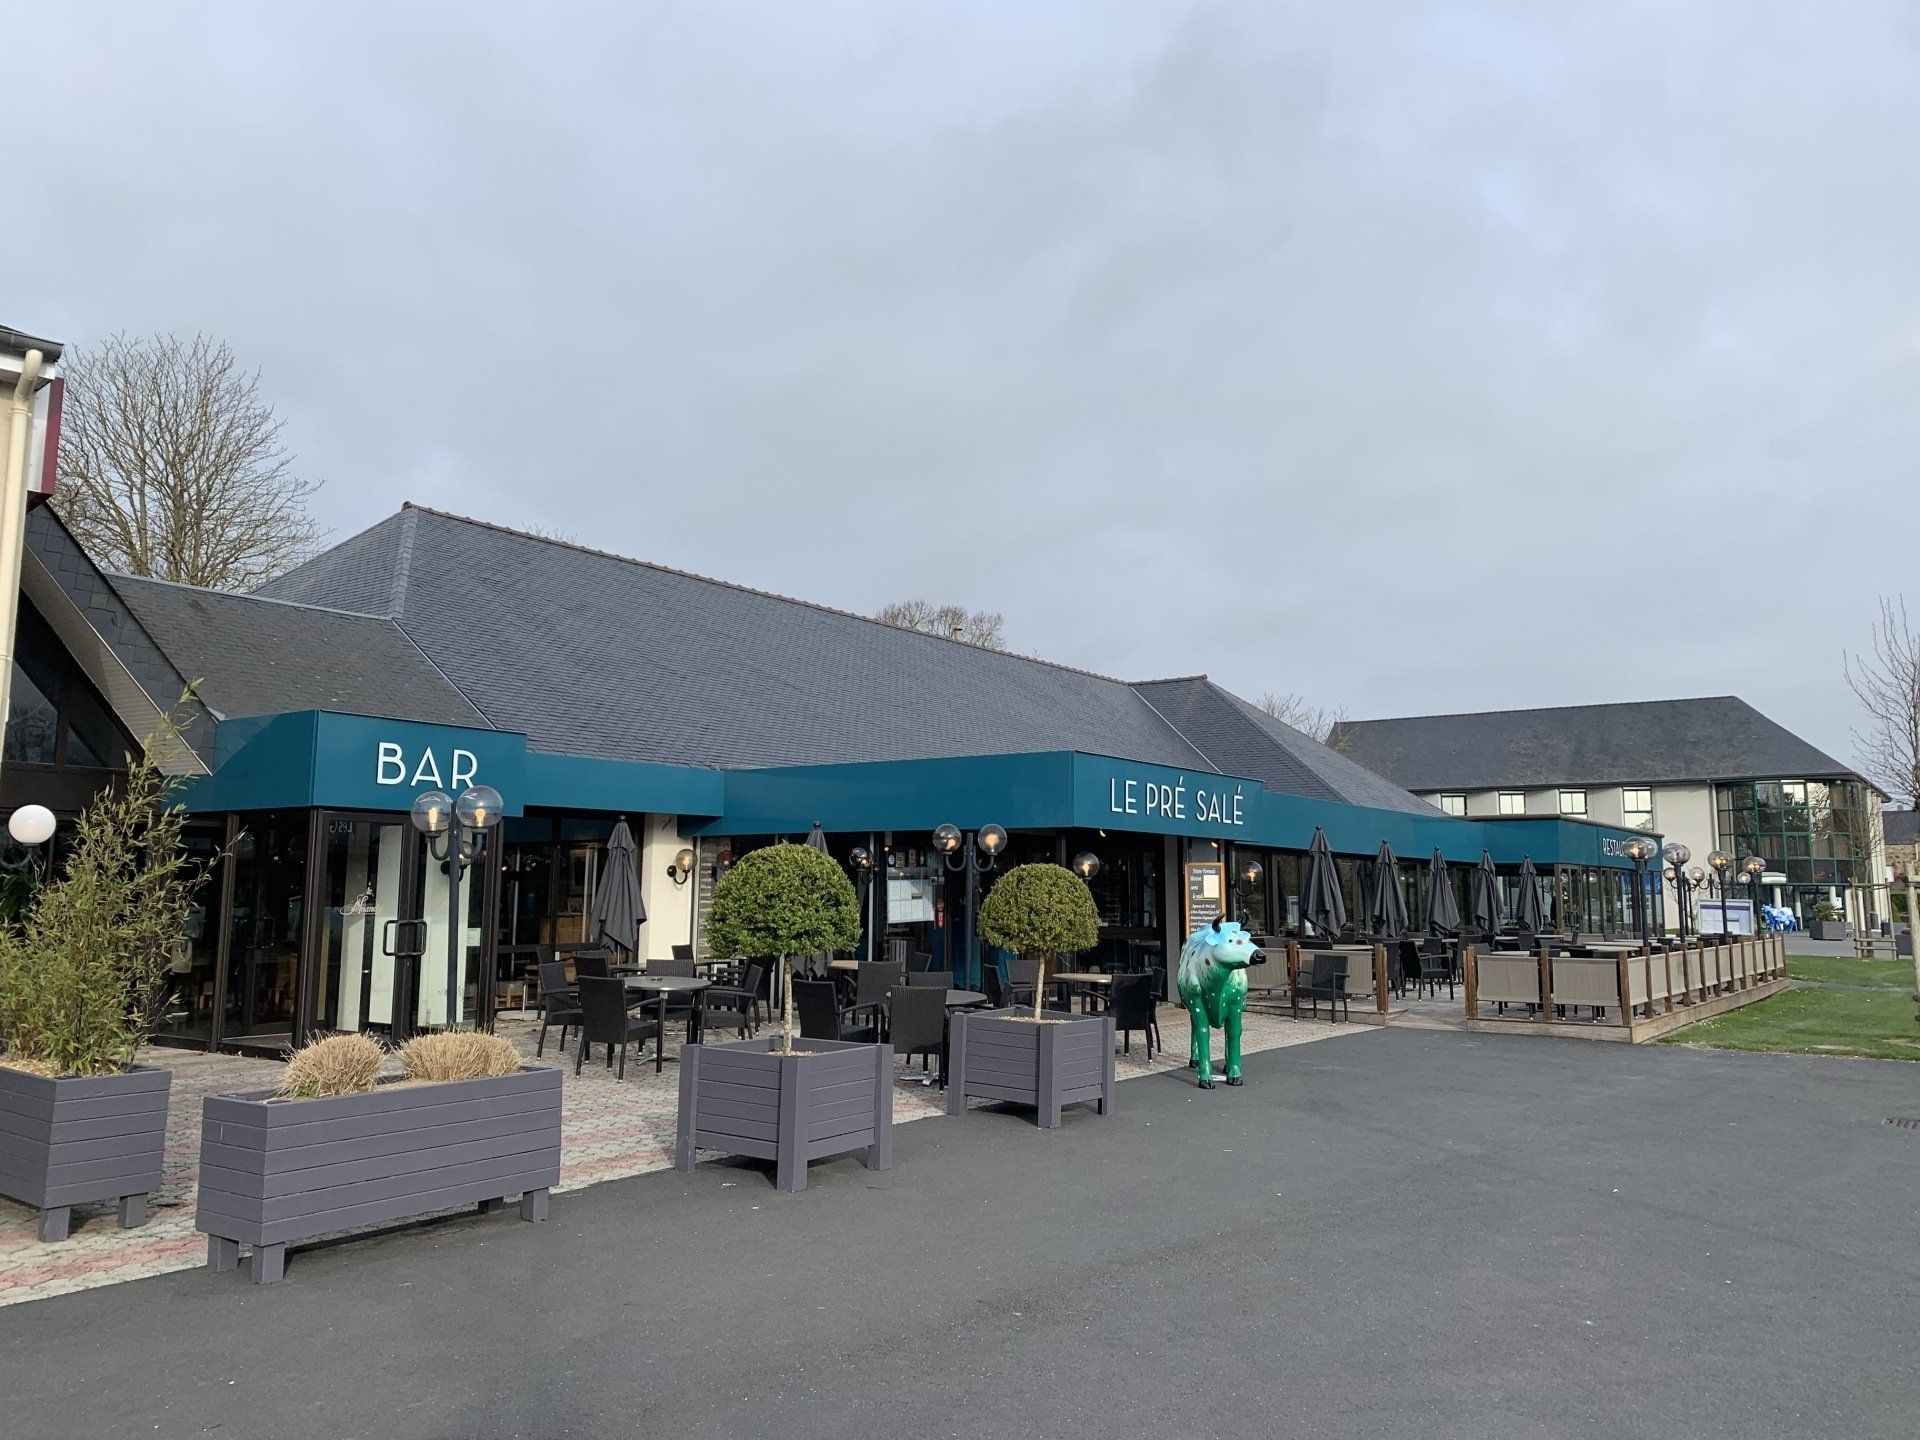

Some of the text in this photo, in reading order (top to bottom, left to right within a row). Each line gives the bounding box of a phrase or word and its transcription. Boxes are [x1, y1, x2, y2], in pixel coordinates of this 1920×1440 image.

[377, 741, 478, 790] BAR
[1111, 776, 1244, 825] LE PRÉ SALÉ
